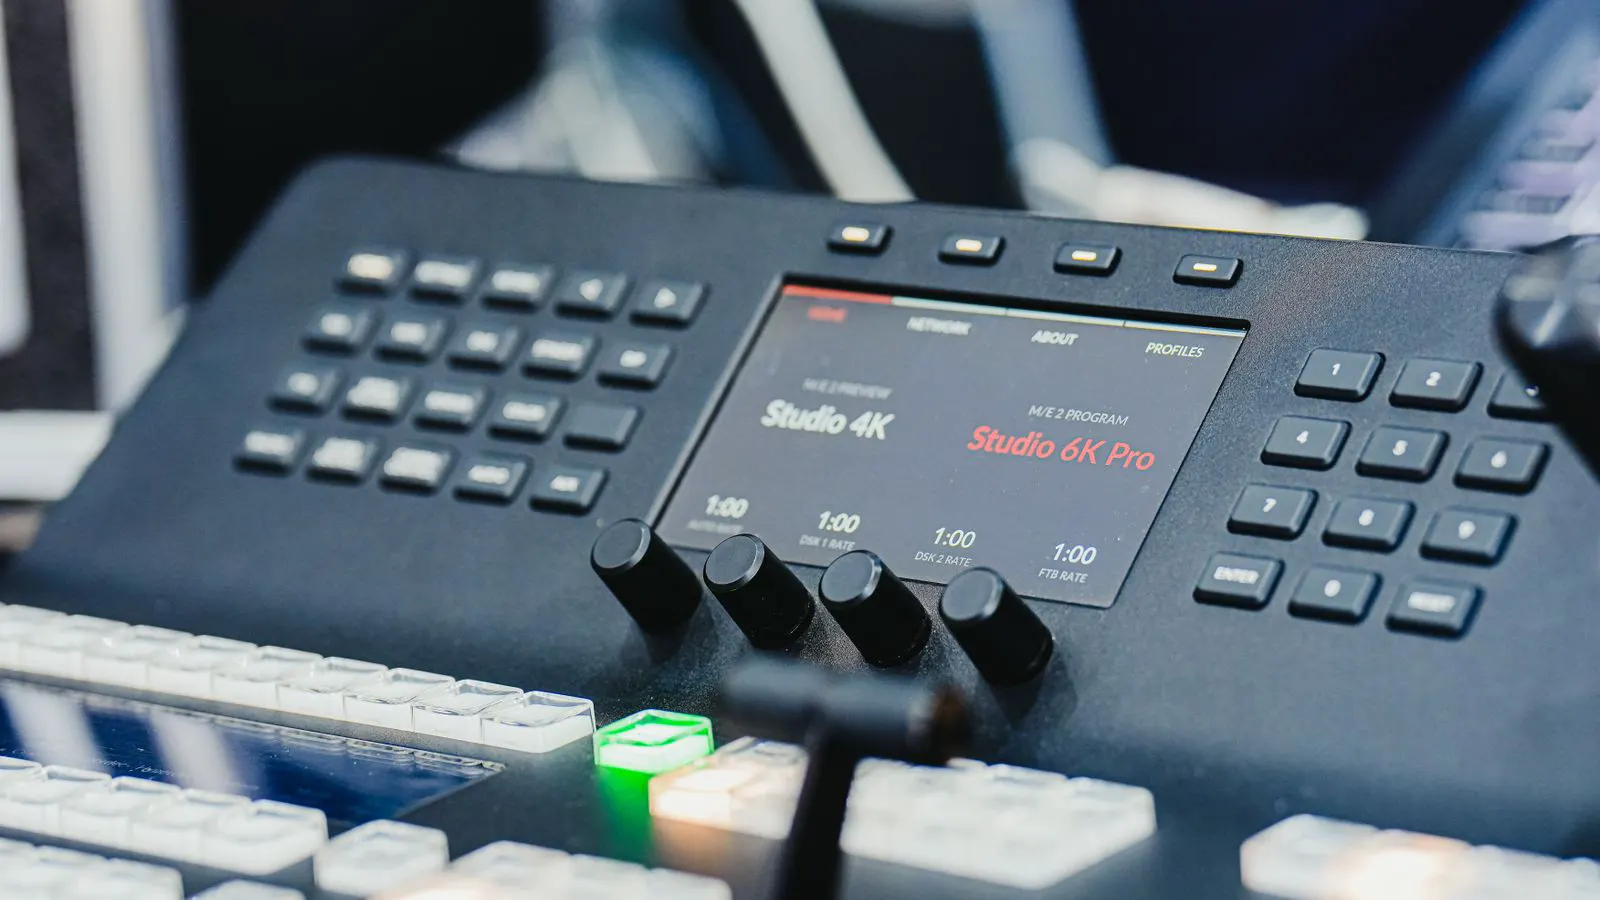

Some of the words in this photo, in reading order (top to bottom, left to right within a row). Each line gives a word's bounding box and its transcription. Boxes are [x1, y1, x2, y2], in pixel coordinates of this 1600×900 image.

[907, 317, 971, 336] NETWORK
[1031, 330, 1078, 347] ABOUT
[1145, 342, 1205, 358] PROFILES
[1331, 363, 1342, 377] 1
[1426, 371, 1442, 387] 2
[761, 399, 847, 435] Studio
[849, 411, 895, 440] 4K
[1028, 405, 1054, 419] M/E
[1054, 408, 1064, 420] 2
[1064, 409, 1129, 426] PROGRAM
[1295, 430, 1310, 445] 4
[967, 425, 1056, 459] Studio
[1060, 437, 1106, 464] 6K
[1106, 442, 1155, 471] Pro
[706, 494, 749, 518] 1:00
[1262, 497, 1278, 513] 7
[818, 511, 861, 533] 1:00
[799, 534, 820, 547] DSK
[829, 539, 856, 551] RATE
[933, 527, 976, 549] 1:00
[914, 551, 936, 563] DSK
[936, 554, 945, 564] 2
[944, 555, 973, 567] RATE
[1052, 543, 1097, 566] 1:00
[1038, 567, 1059, 580] FTB
[1060, 571, 1089, 584] RATE
